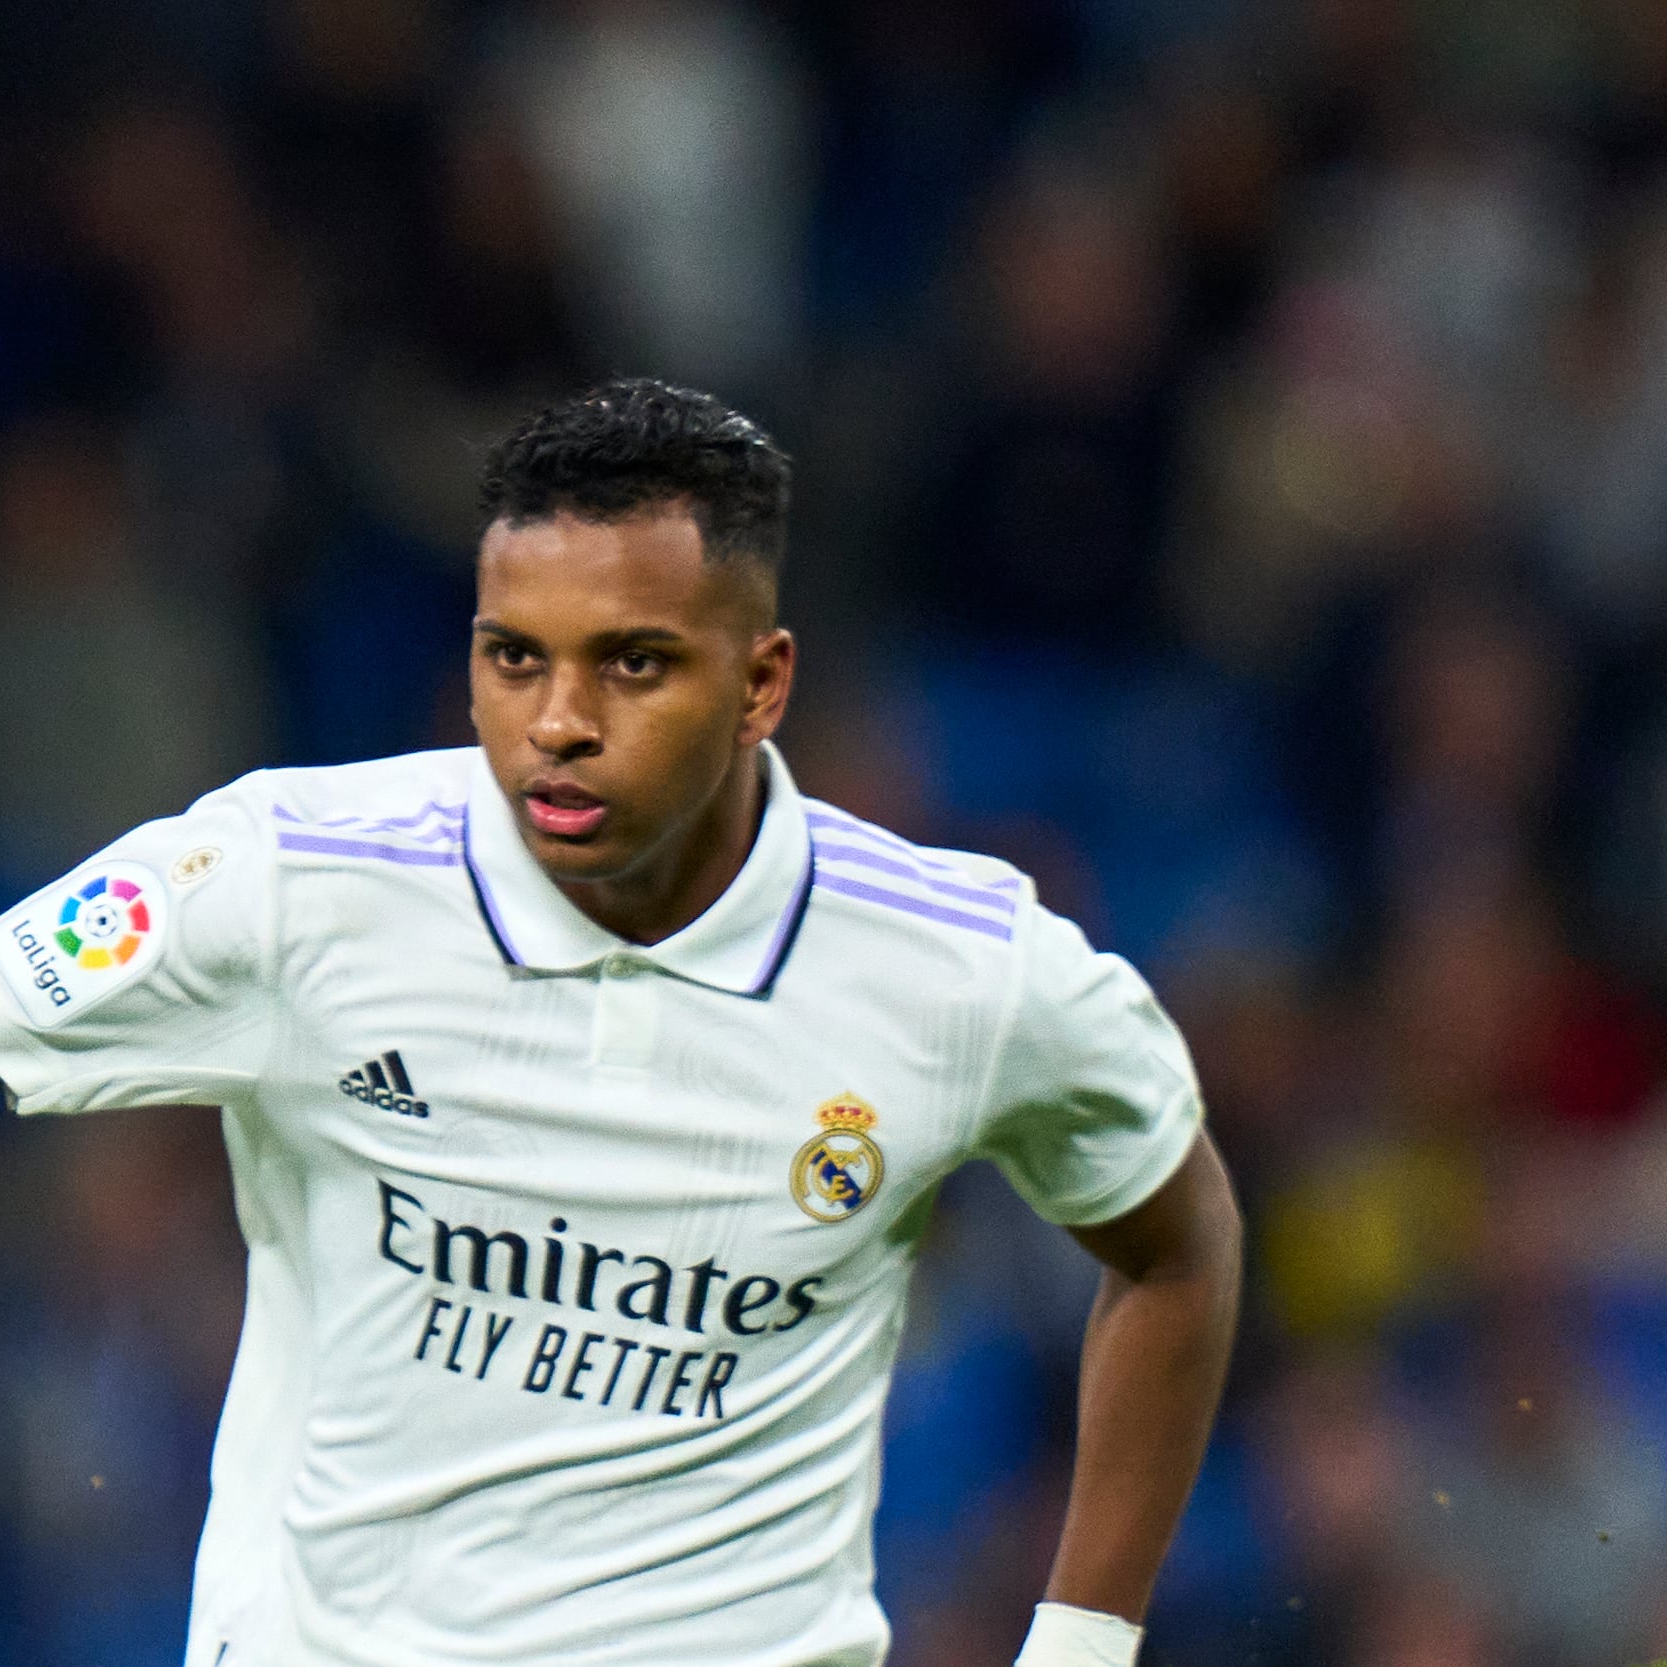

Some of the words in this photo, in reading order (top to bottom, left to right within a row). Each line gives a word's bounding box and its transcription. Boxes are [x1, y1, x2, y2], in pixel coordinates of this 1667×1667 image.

[11, 919, 72, 1008] LaLiga
[339, 1078, 430, 1119] adidas
[377, 1177, 826, 1337] Emirates
[413, 1297, 515, 1381] FLY
[521, 1323, 740, 1420] BETTER
